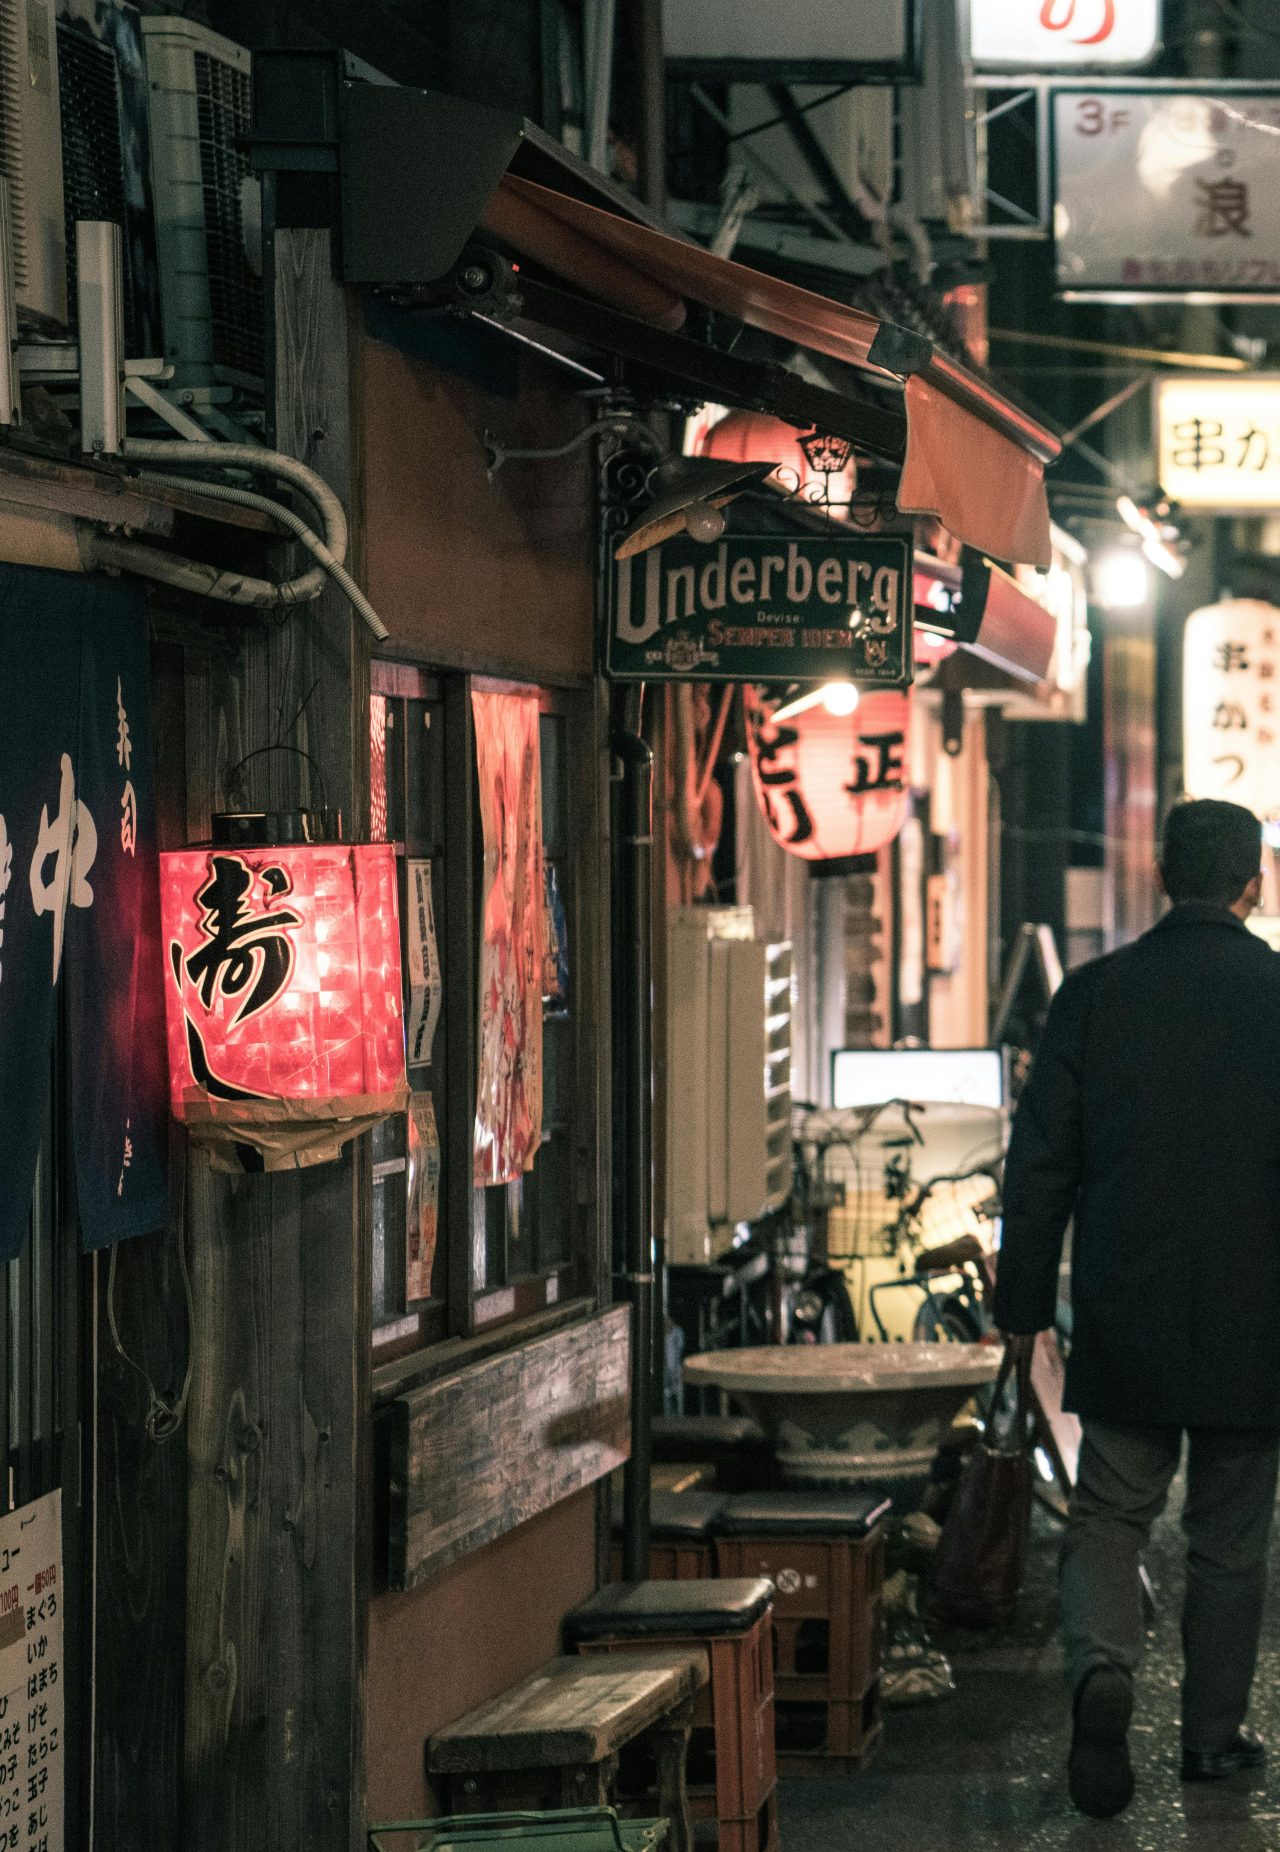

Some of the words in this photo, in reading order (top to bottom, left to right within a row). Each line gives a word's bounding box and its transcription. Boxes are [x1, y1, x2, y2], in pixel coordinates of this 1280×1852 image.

[616, 542, 899, 645] Underberg
[26, 1593, 57, 1631] まぐろ
[27, 1635, 48, 1664] いか
[27, 1662, 58, 1700] はまち
[27, 1702, 48, 1734] げそ
[0, 1721, 20, 1756] みそ
[27, 1727, 58, 1769] たらこ
[27, 1767, 48, 1803] 玉子
[27, 1804, 48, 1836] あじ
